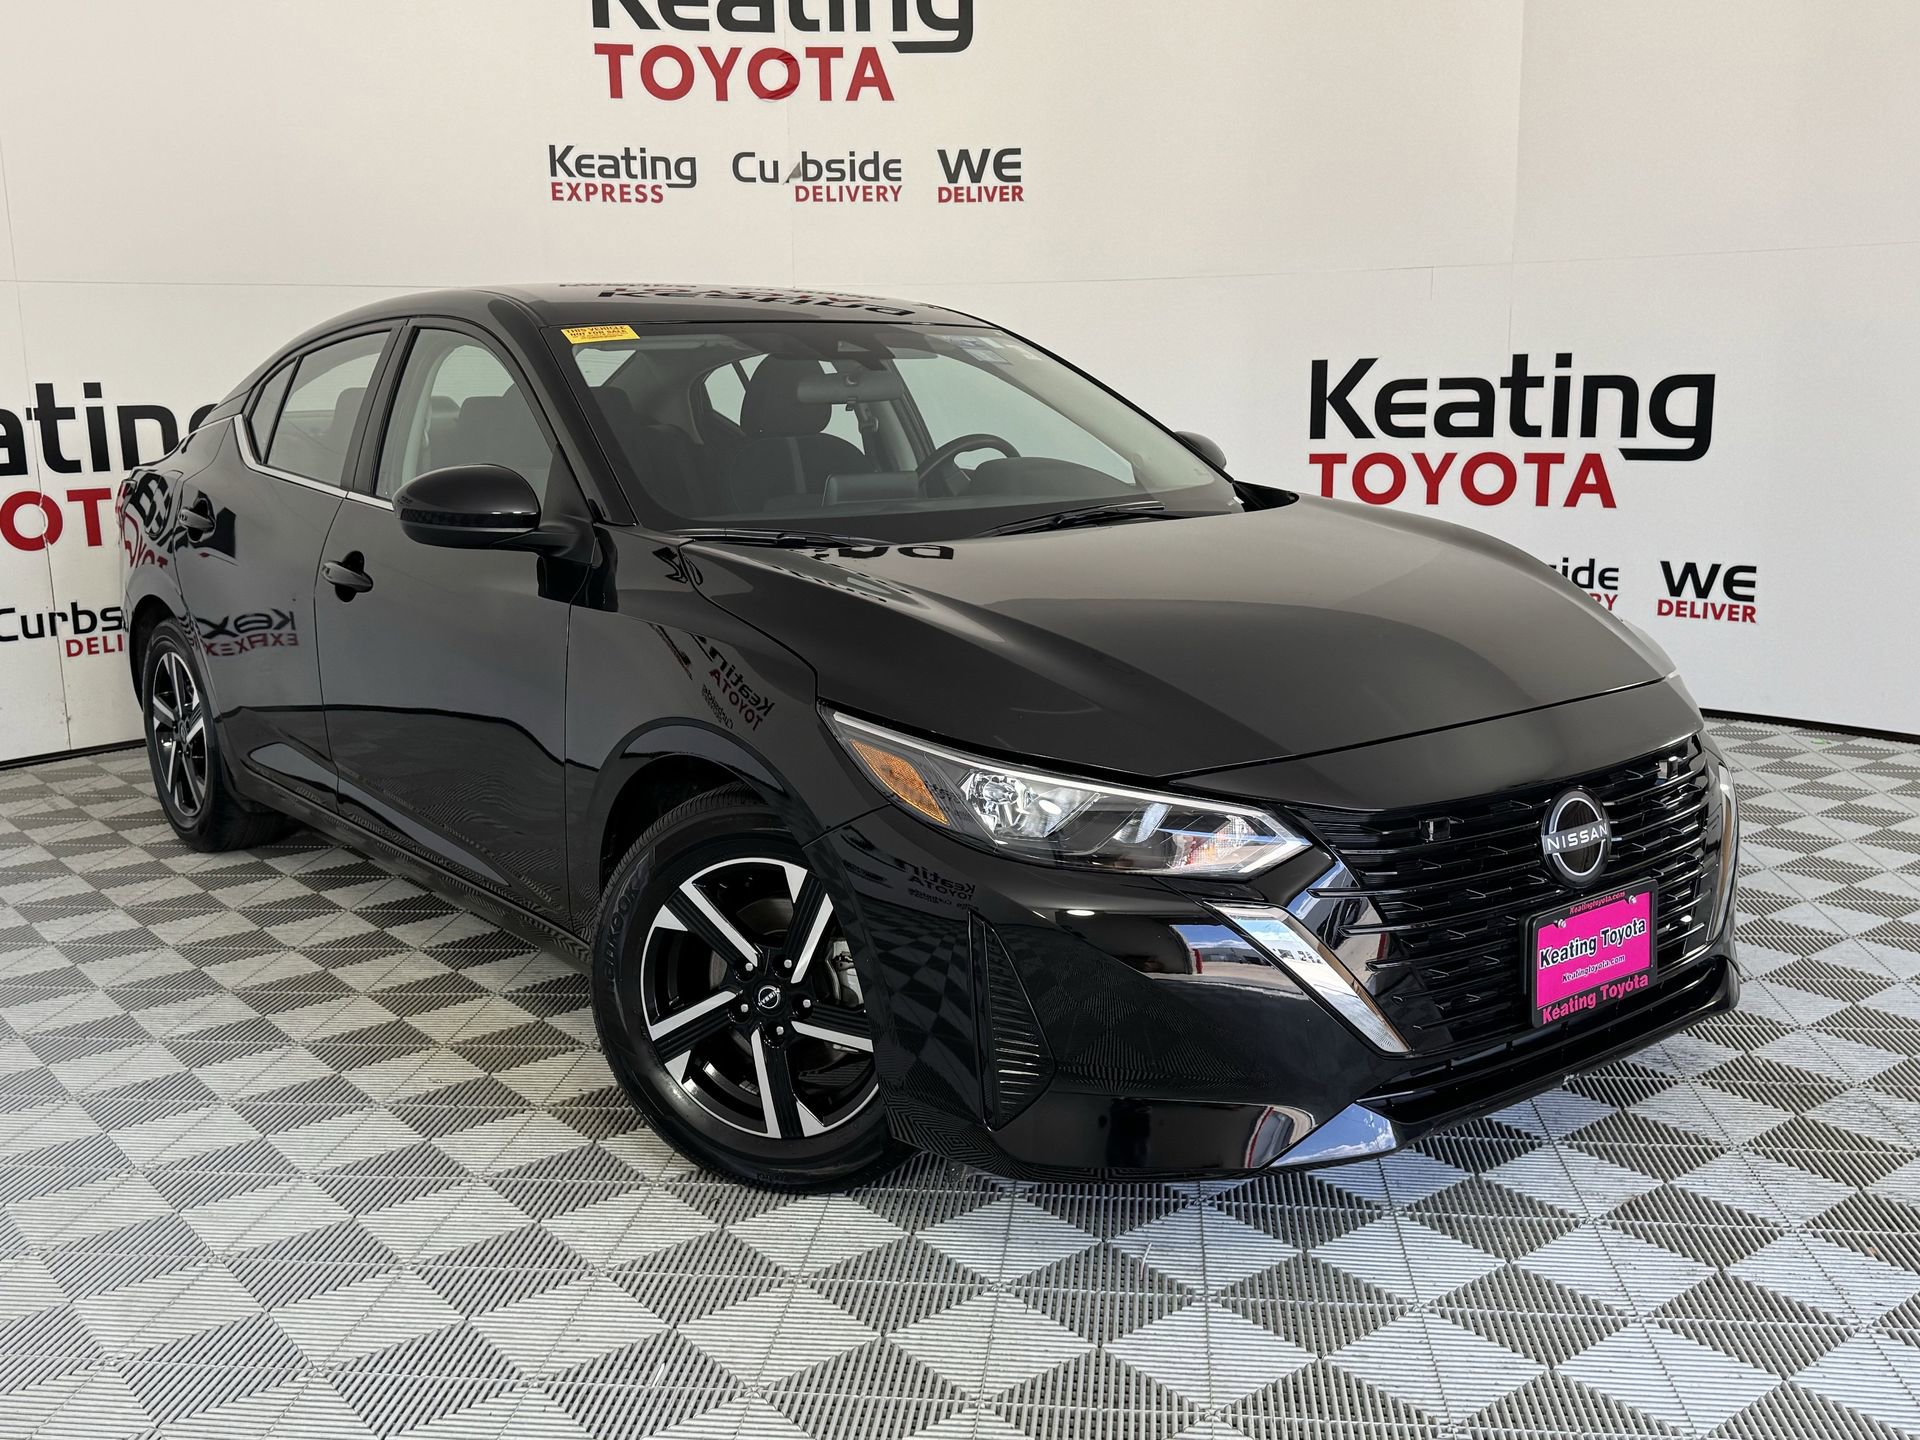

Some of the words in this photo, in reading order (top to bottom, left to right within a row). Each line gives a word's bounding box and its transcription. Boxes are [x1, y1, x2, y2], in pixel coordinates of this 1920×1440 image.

[593, 43, 895, 102] TOYOTA
[548, 144, 697, 188] Keating
[732, 150, 902, 184] Cubside
[937, 148, 1022, 184] WE
[550, 182, 665, 203] EXPRESS
[794, 185, 903, 202] DELIVERY
[938, 186, 1025, 203] DELIVER
[1309, 353, 1716, 462] Keating
[1309, 451, 1617, 509] TOYOTA
[1548, 557, 1619, 591] ide
[1660, 560, 1758, 603] WE
[1657, 599, 1757, 624] DELIVER
[1546, 822, 1608, 851] NISSAN
[1540, 937, 1597, 969] Keating
[1600, 919, 1647, 947] Toyota
[1562, 955, 1625, 982] Keatingtoyota.com
[1542, 993, 1597, 1025] Keating
[1600, 974, 1649, 1001] Toyota
